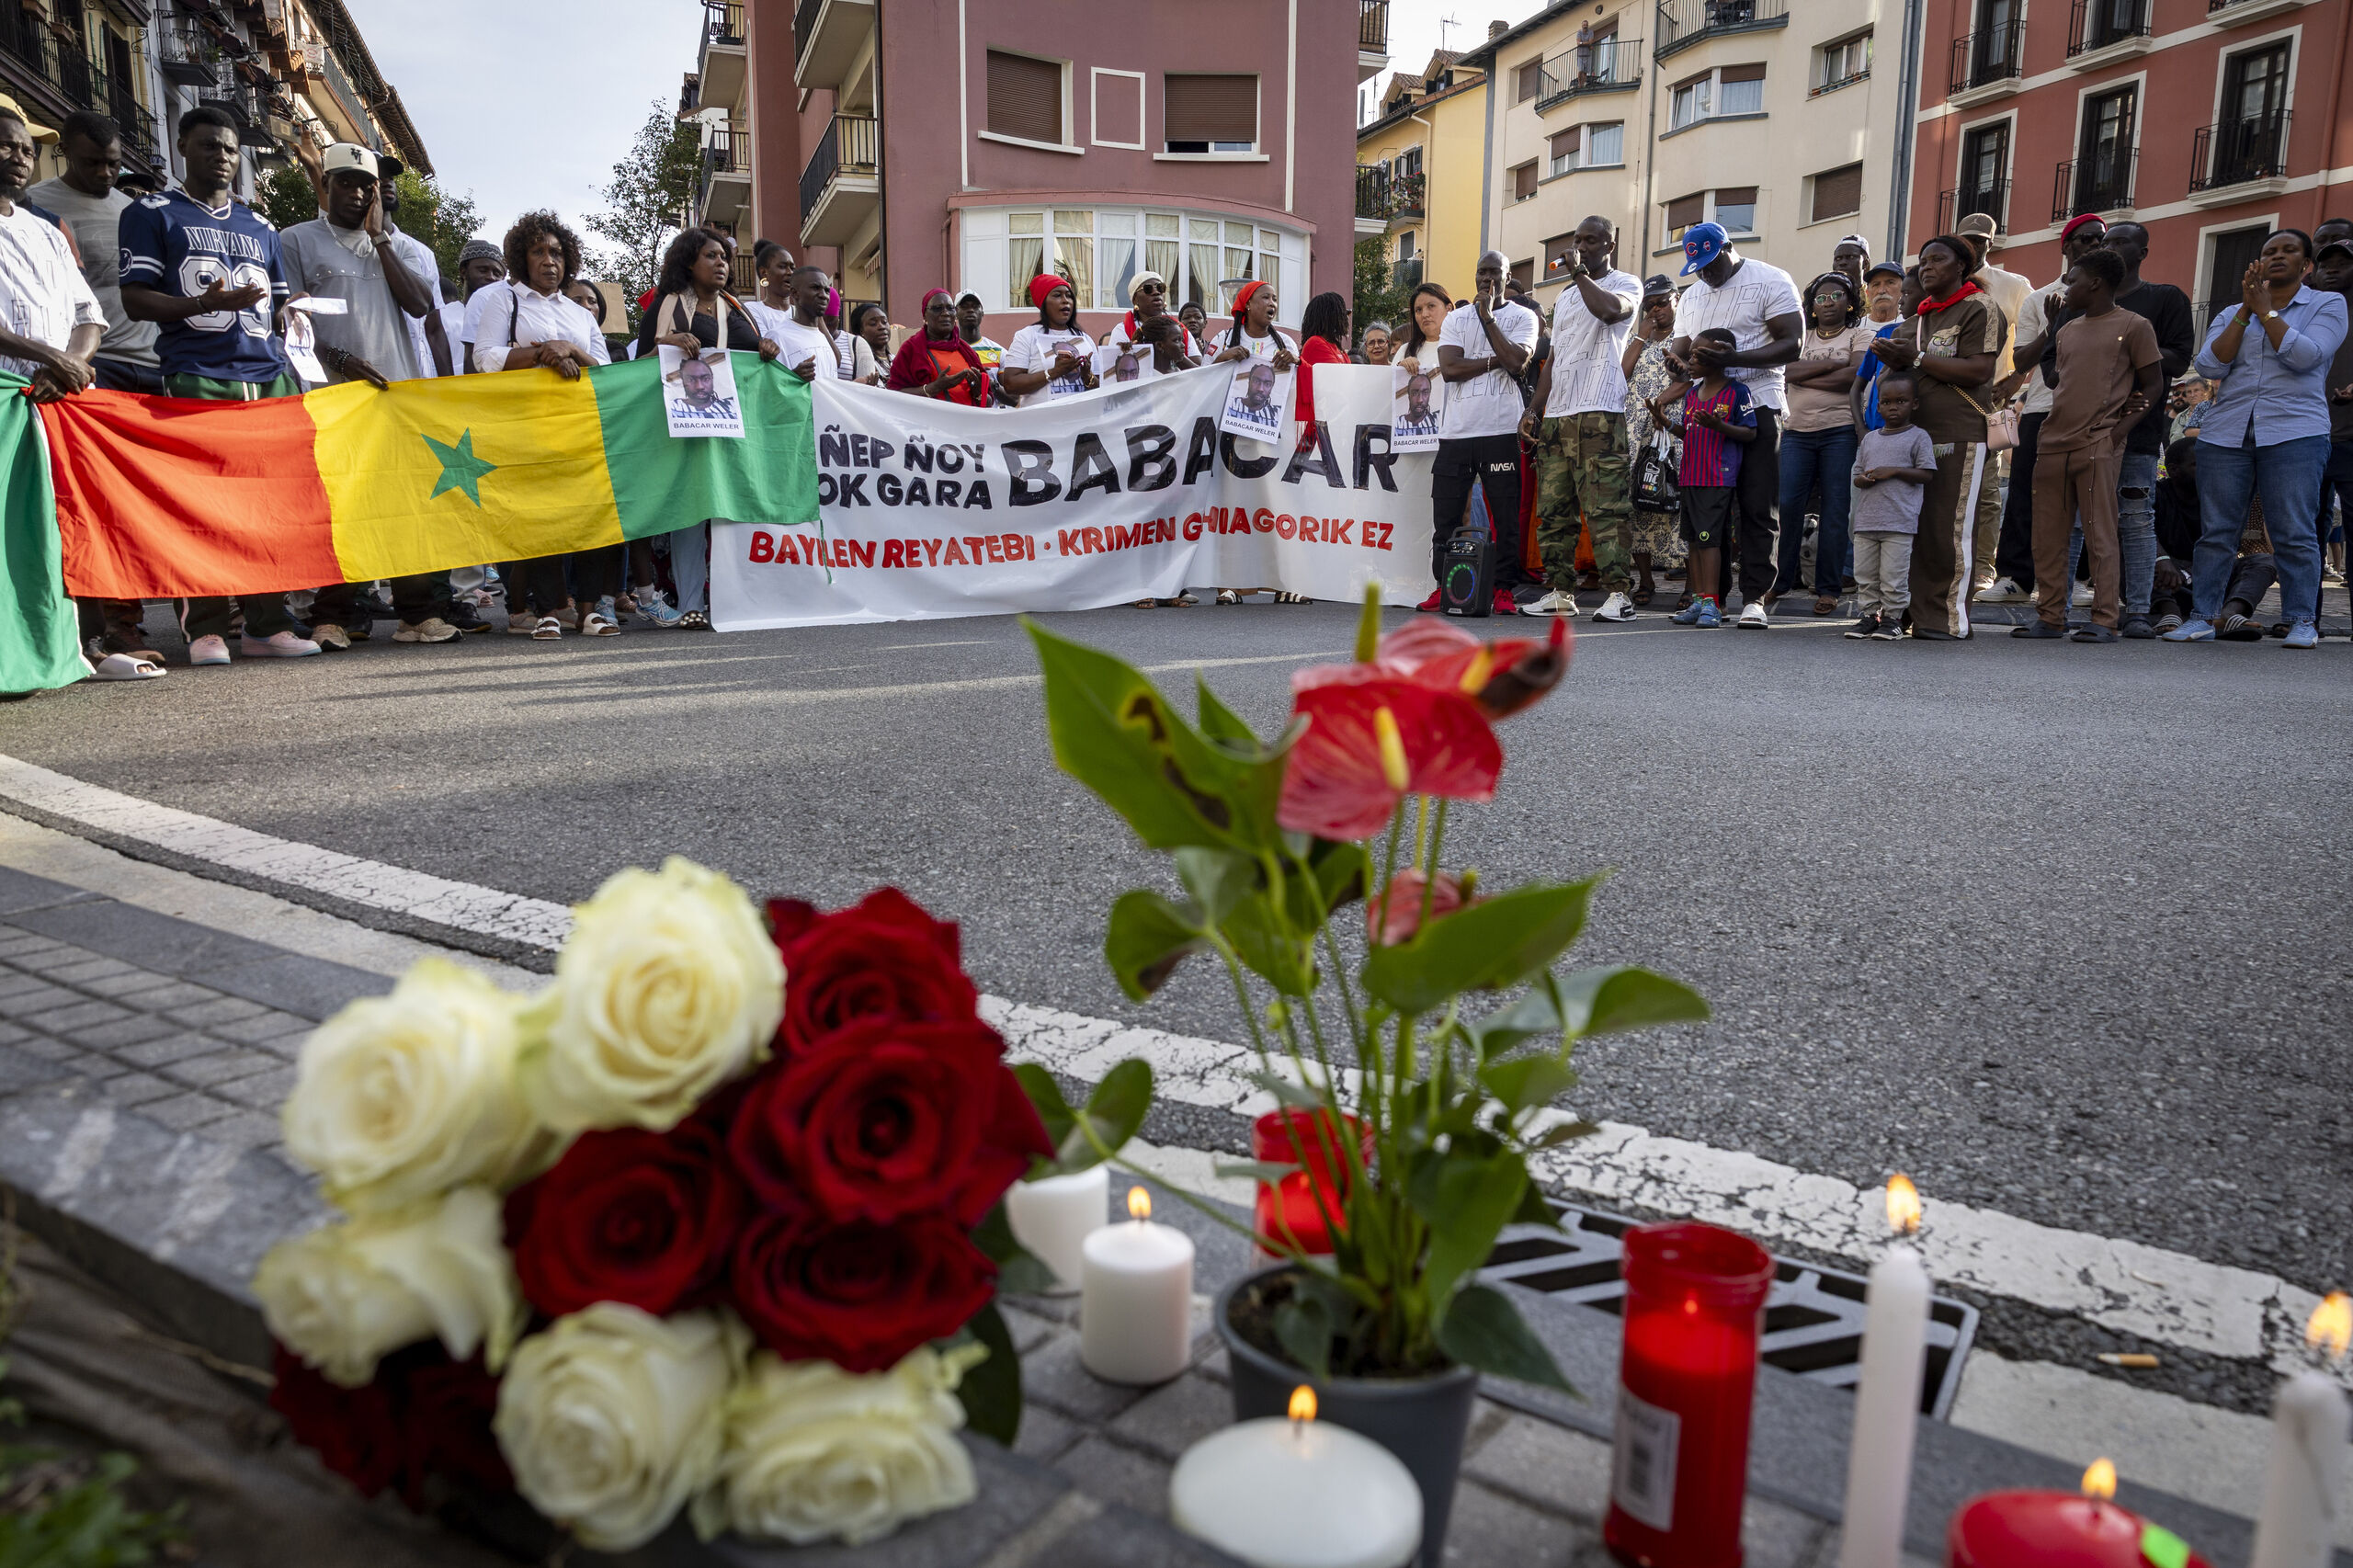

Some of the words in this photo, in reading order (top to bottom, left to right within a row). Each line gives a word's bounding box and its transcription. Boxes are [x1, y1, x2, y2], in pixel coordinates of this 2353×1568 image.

[183, 226, 266, 264] NIRVANA
[1225, 419, 1255, 432] BABACAR
[1255, 426, 1276, 437] WELER
[1393, 438, 1419, 447] BABACAR
[819, 424, 895, 469] ÑEP
[904, 434, 985, 474] ÑOY
[1001, 416, 1398, 507] BABACAR
[1490, 462, 1516, 472] NASA
[877, 473, 993, 509] GARA
[882, 533, 1036, 568] REYATEBI
[1058, 516, 1176, 556] KRIMEN
[1361, 520, 1394, 551] EZ
